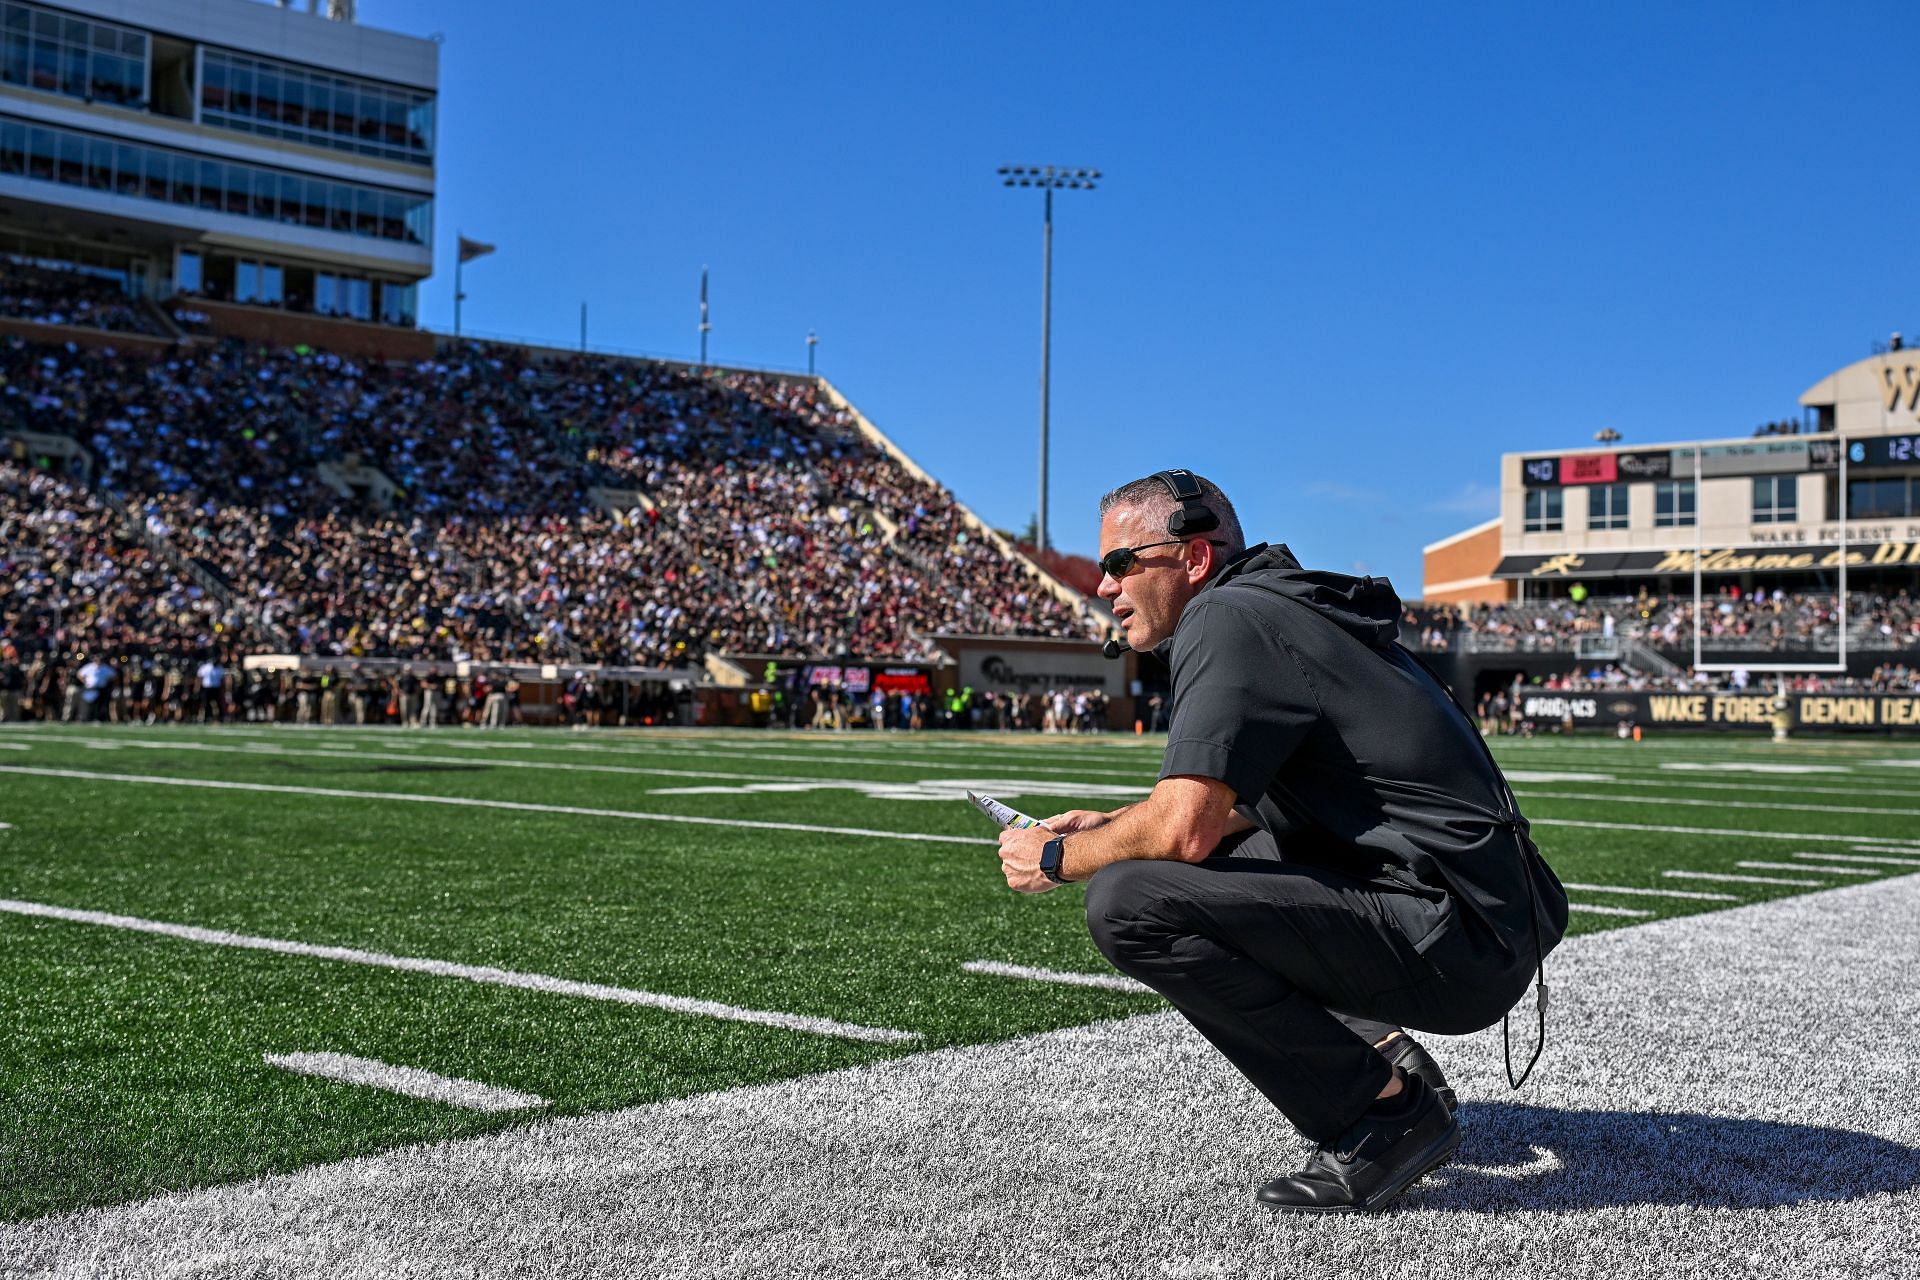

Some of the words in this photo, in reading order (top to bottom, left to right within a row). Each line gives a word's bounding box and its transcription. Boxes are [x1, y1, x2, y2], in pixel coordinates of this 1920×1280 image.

[1528, 460, 1553, 481] 40
[1751, 529, 1805, 541] WAKE
[1819, 526, 1894, 540] FOREST
[1649, 696, 1707, 722] WAKE
[1712, 696, 1779, 723] FORES
[1801, 698, 1875, 724] DEMON
